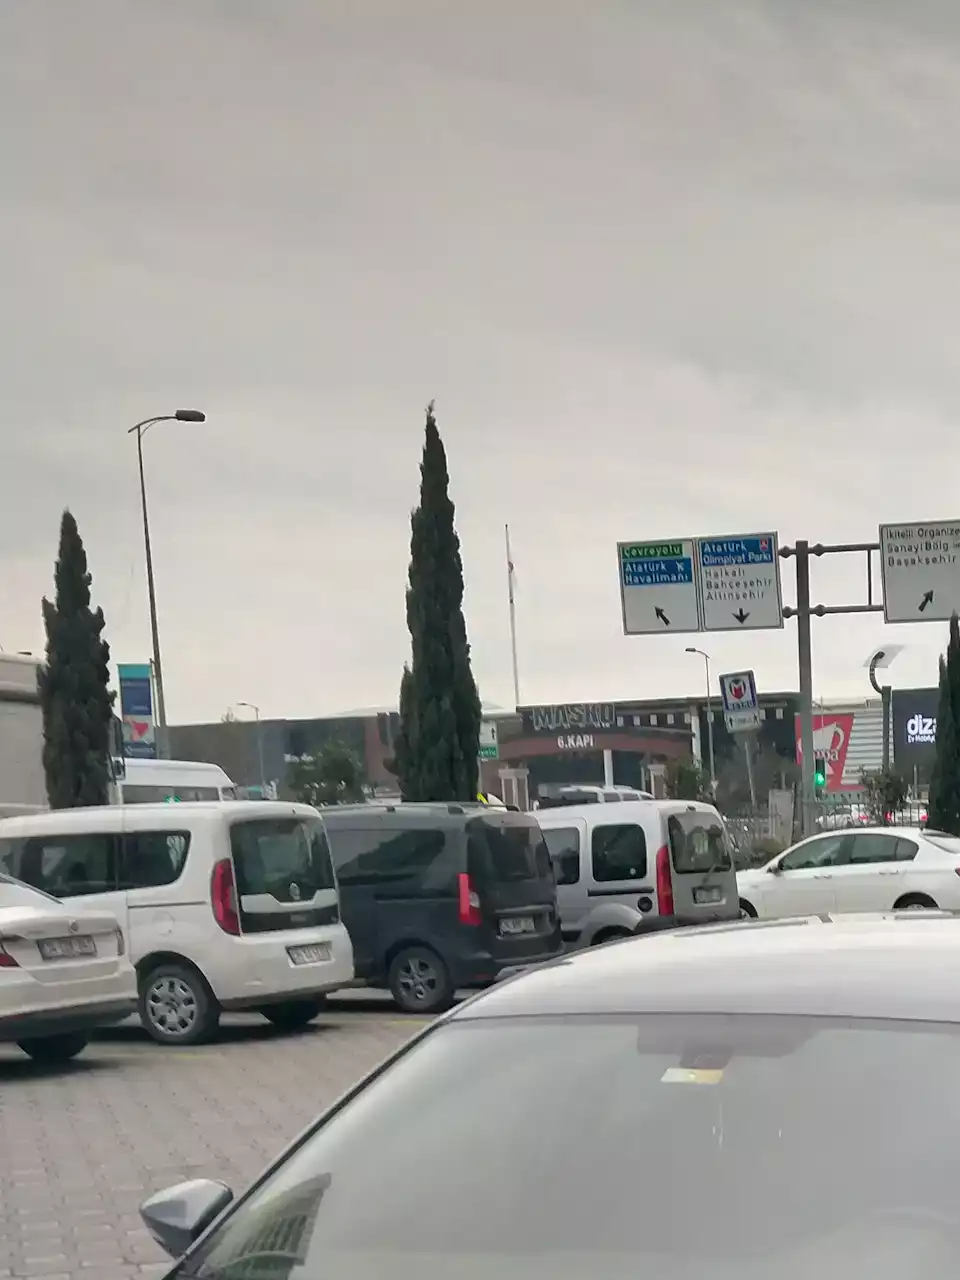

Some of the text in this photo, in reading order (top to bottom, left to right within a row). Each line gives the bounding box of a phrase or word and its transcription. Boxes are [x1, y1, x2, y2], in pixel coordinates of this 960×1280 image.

[917, 527, 960, 539] Organize
[623, 543, 681, 558] Çevreyolu
[703, 541, 747, 553] Atatürk
[887, 542, 923, 554] Sanayi
[703, 551, 772, 566] Olimpiyat Parkı
[888, 554, 957, 567] Başakşehir
[624, 562, 667, 573] Atatürk
[705, 567, 745, 579] Halkalı
[624, 572, 689, 585] Havalimanı
[706, 578, 772, 591] Bahçeşehir
[706, 590, 765, 602] Altınşehir
[557, 734, 594, 749] 6.KAPI
